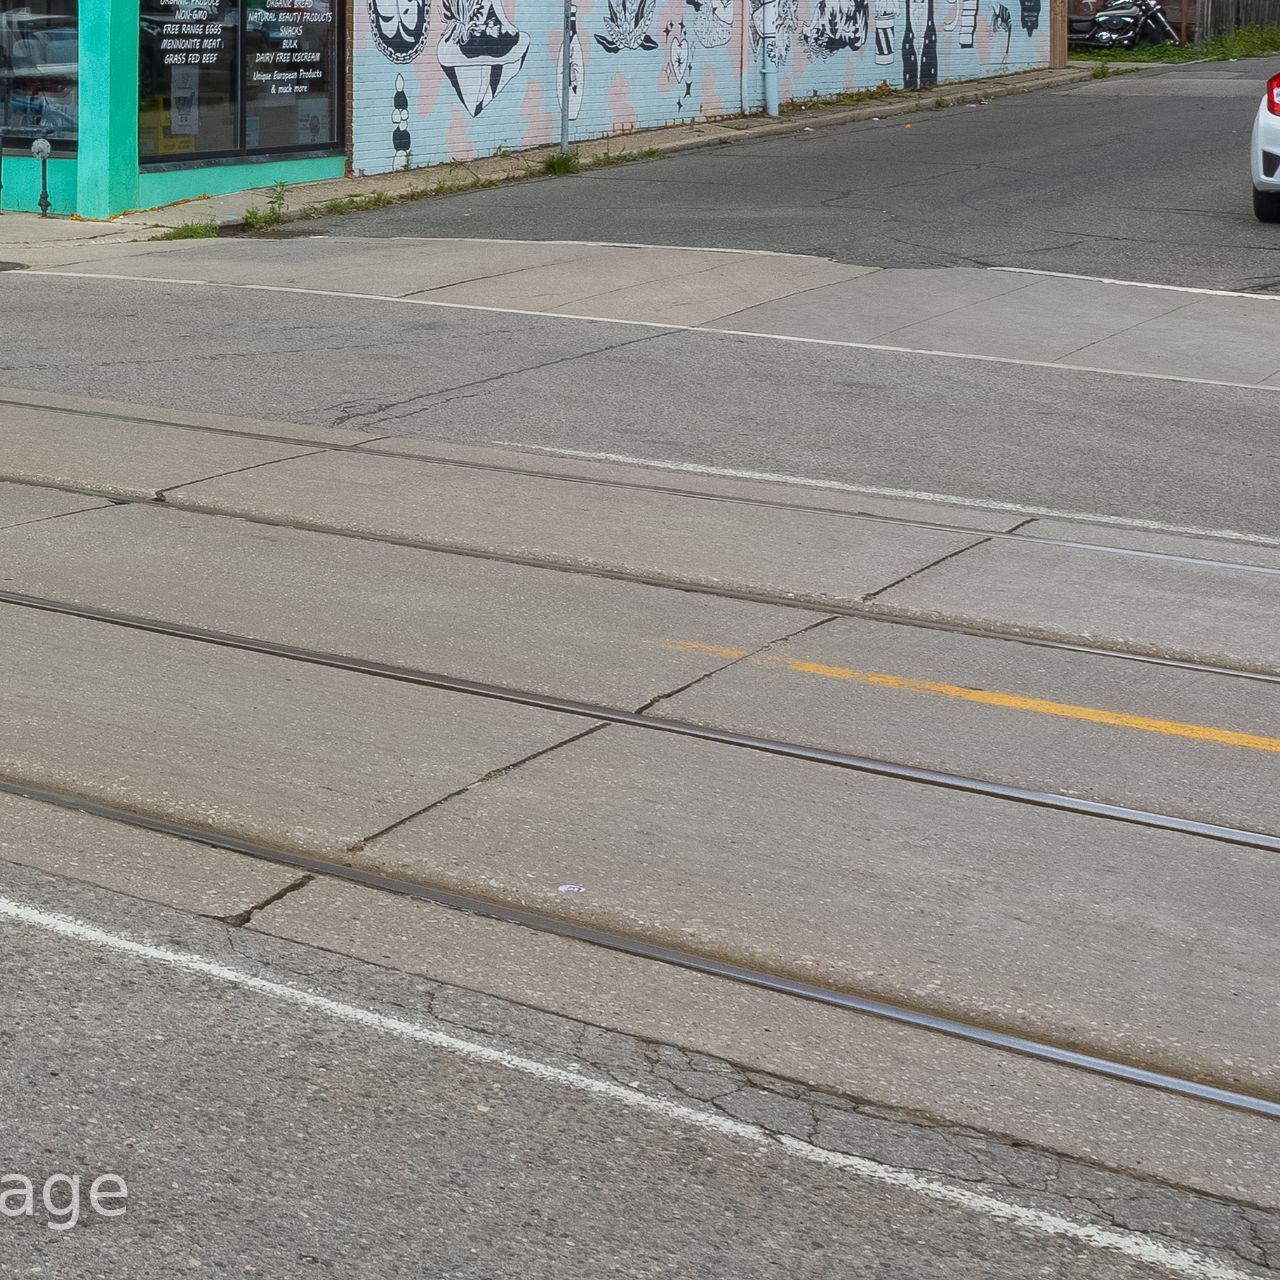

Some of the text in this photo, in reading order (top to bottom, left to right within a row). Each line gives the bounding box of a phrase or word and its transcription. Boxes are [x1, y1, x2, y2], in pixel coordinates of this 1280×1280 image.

[175, 10, 208, 20] NON-GMO
[248, 12, 333, 23] NATURAL BEAUTY PRODUCTS
[163, 24, 222, 34] FREE RANGE EGGS
[280, 25, 303, 36] SNACKS
[161, 39, 221, 49] MENNONITE MEAT
[282, 39, 298, 49] BULK
[164, 53, 219, 64] GRASS FED BEEF
[255, 52, 275, 63] DAIRY
[275, 52, 291, 63] FREE
[252, 68, 323, 83] Unique European Products
[270, 83, 308, 94] & much more
